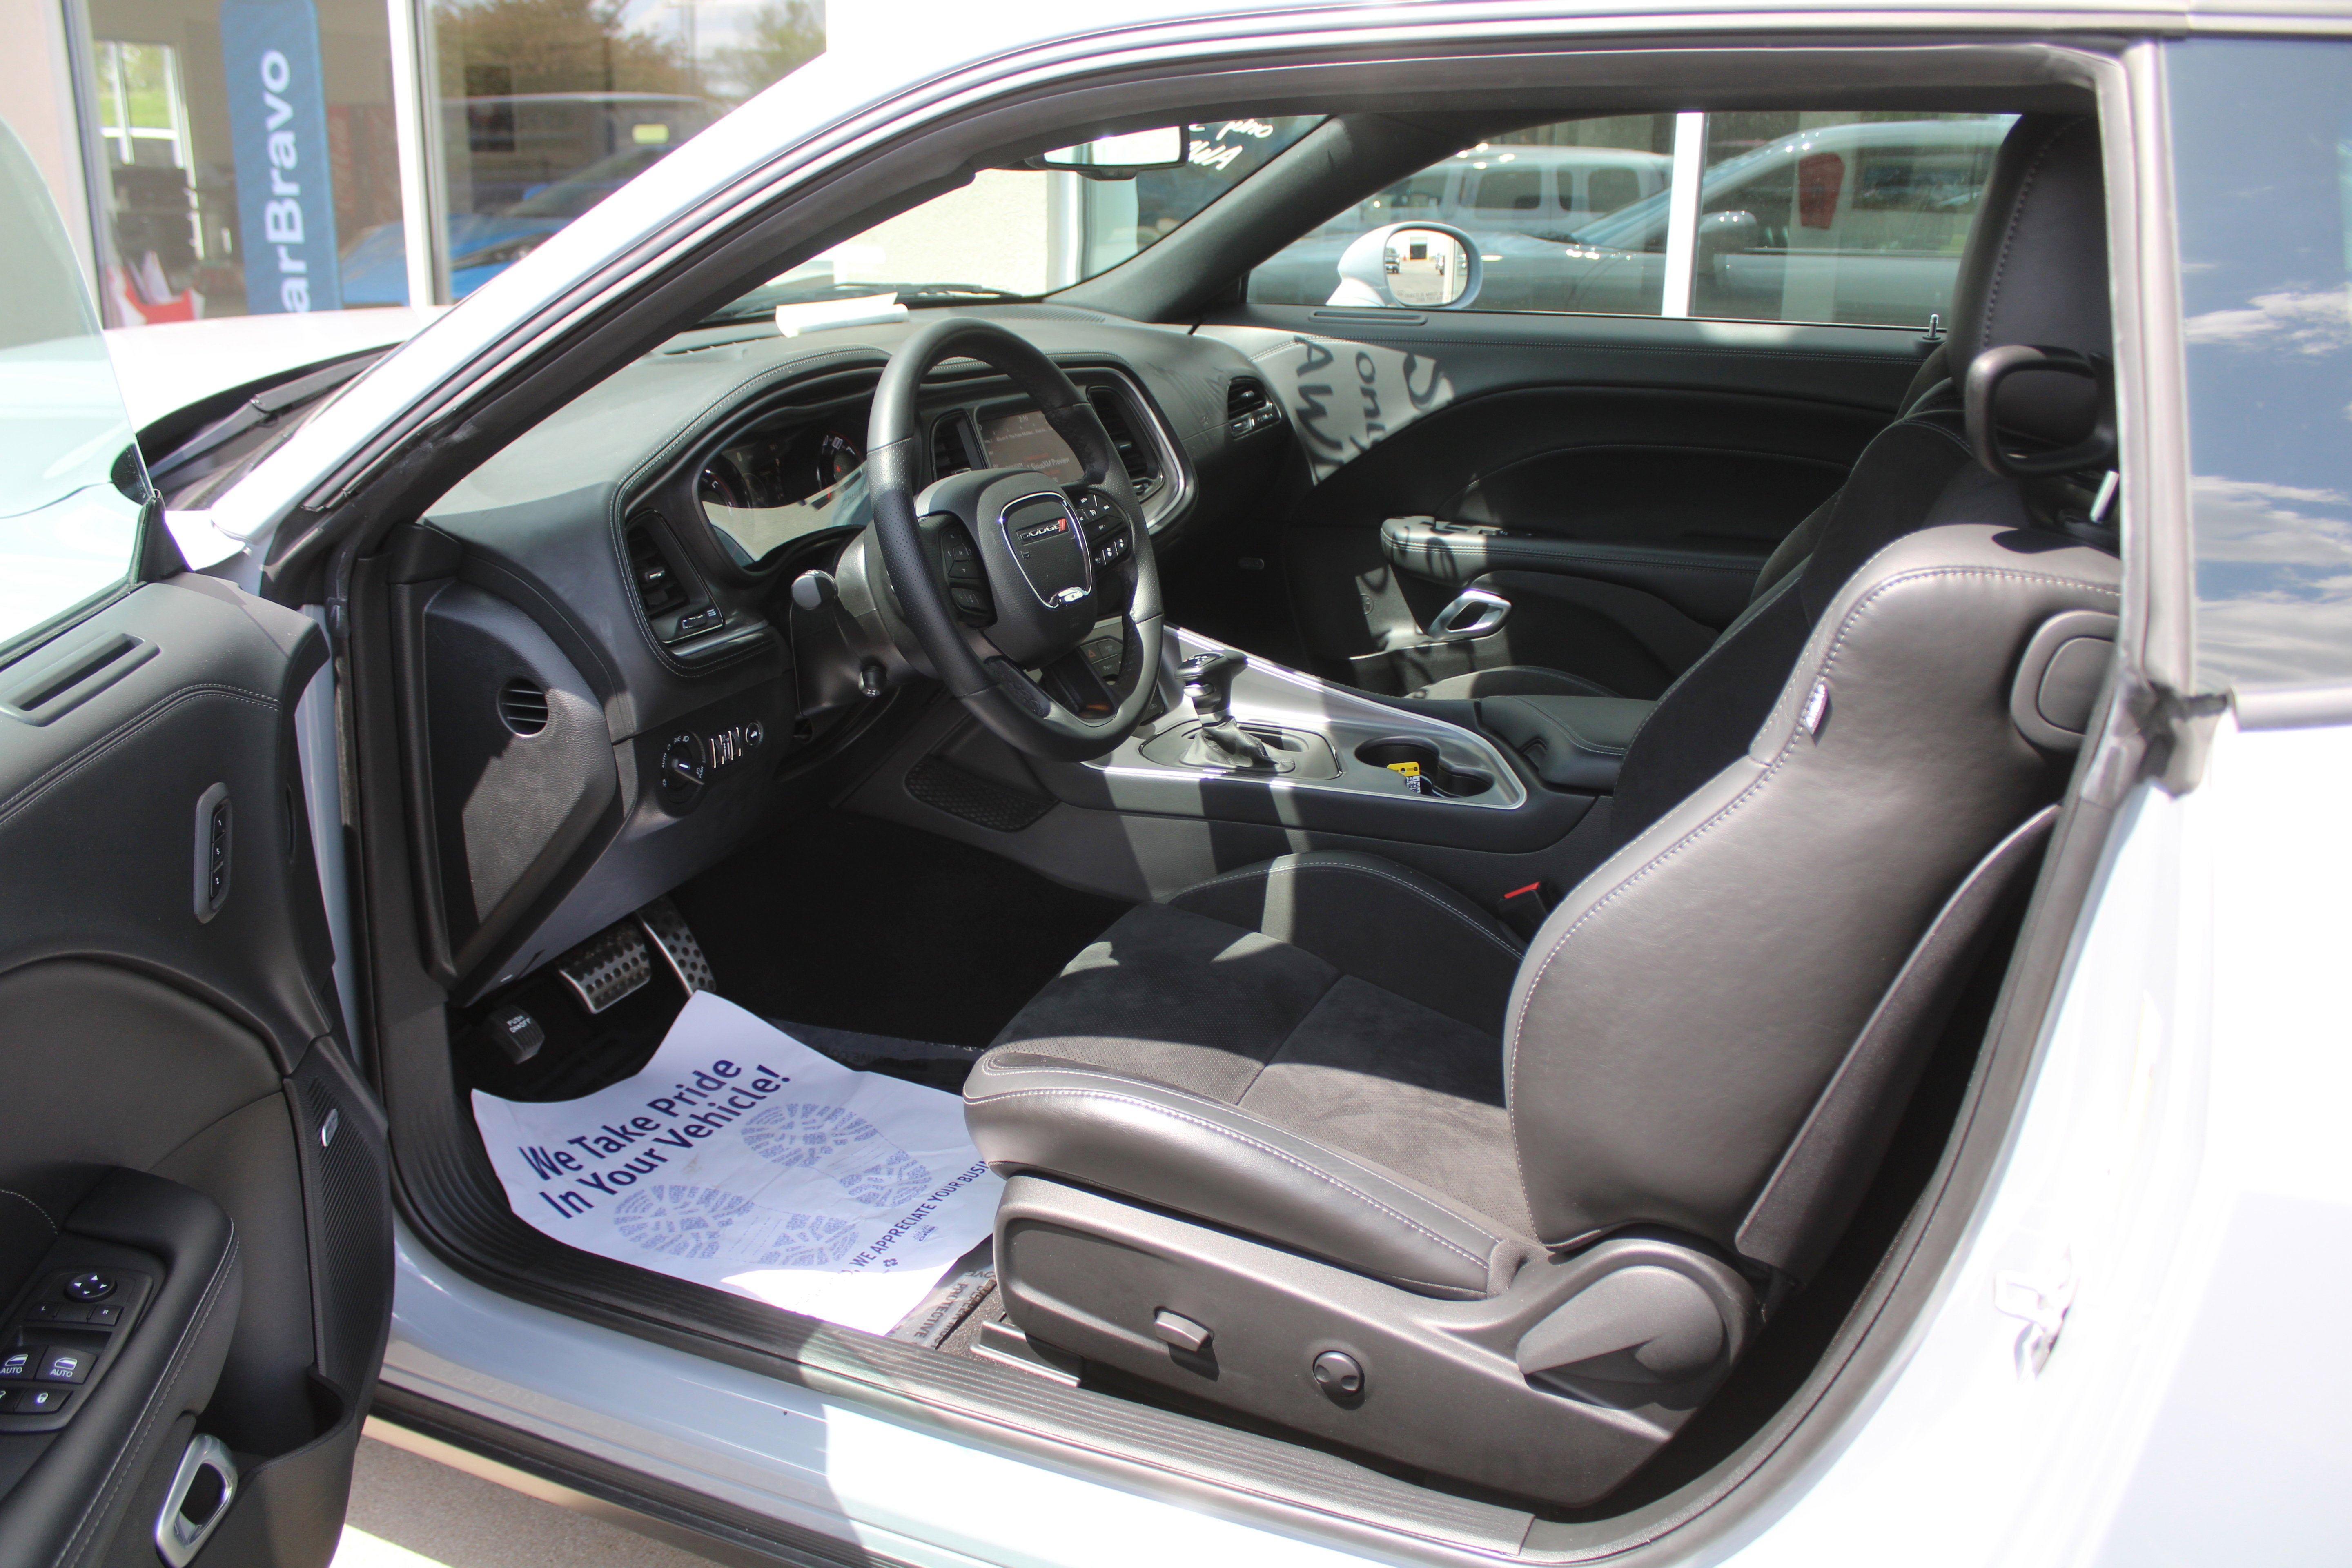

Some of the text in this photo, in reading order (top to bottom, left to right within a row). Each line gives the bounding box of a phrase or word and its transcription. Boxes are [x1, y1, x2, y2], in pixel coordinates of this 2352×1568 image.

[260, 49, 312, 313] arBravo
[1051, 457, 1070, 467] Preview
[1020, 523, 1060, 539] DODGE
[506, 1015, 525, 1026] PUSH
[518, 1059, 742, 1181] We Take Pride
[539, 1063, 791, 1220] In Your Vehicle!
[849, 1251, 877, 1267] WE
[870, 1203, 937, 1255] APPRECIATE
[927, 1181, 965, 1203] YOUR
[914, 1283, 969, 1339] PROTECTIVE
[50, 1368, 73, 1377] AUTO
